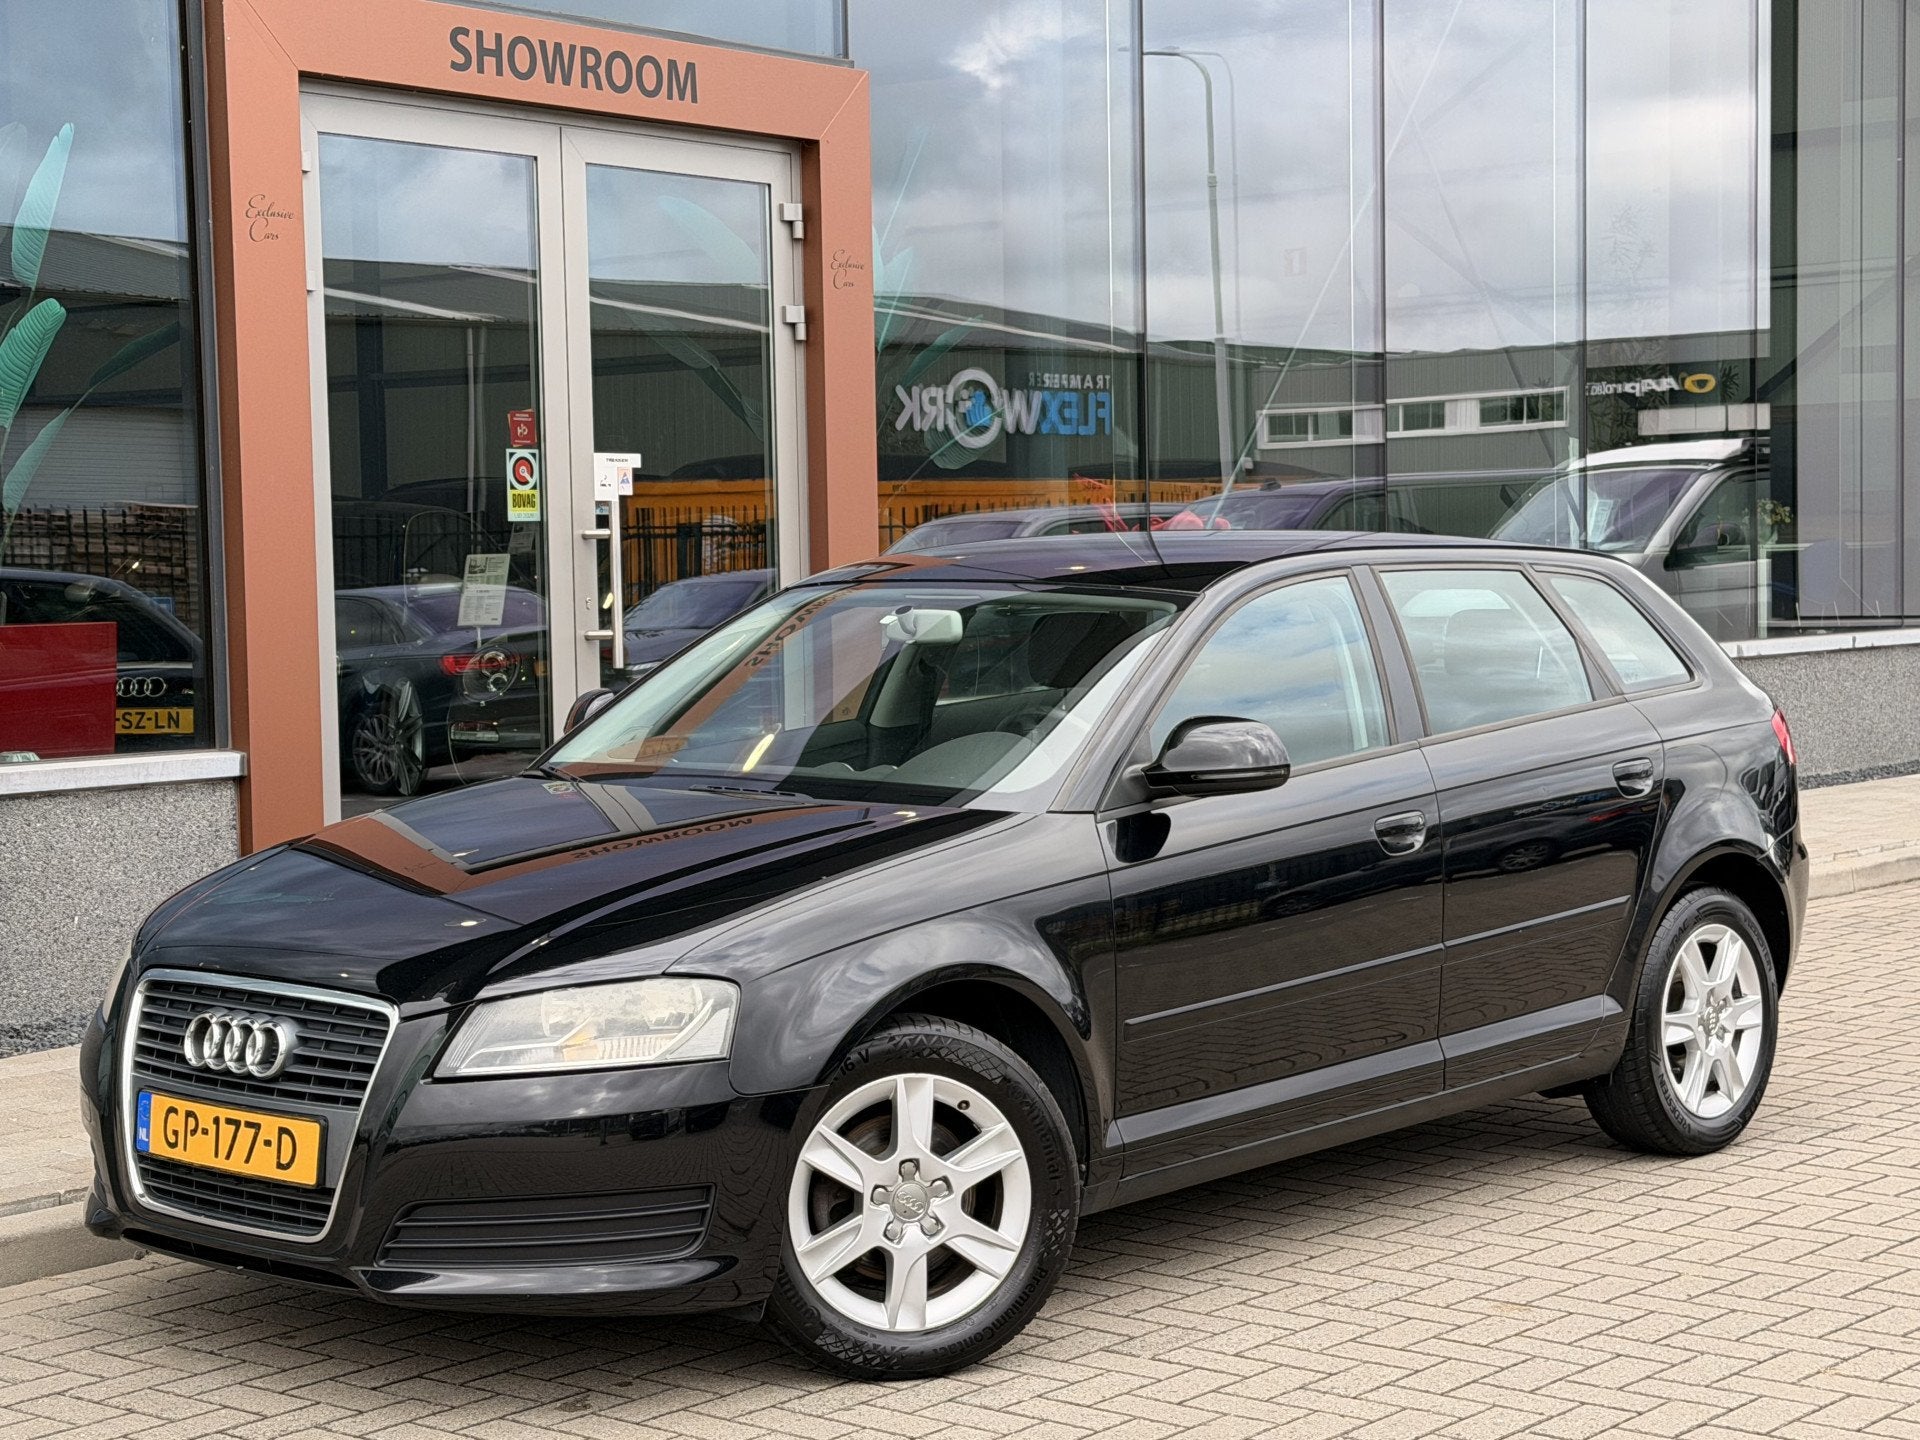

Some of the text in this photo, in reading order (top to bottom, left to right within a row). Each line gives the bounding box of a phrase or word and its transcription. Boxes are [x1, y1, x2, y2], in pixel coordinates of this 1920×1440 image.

[448, 26, 698, 104] SHOWROOM
[245, 194, 294, 220] Exclusive
[249, 217, 279, 243] Cars
[512, 493, 536, 509] BOVAG
[1657, 1072, 1692, 1134] VREDESTEIN
[138, 1126, 149, 1141] NL
[163, 1105, 298, 1171] GP-177-D
[932, 1265, 1049, 1356] PremiumContact
